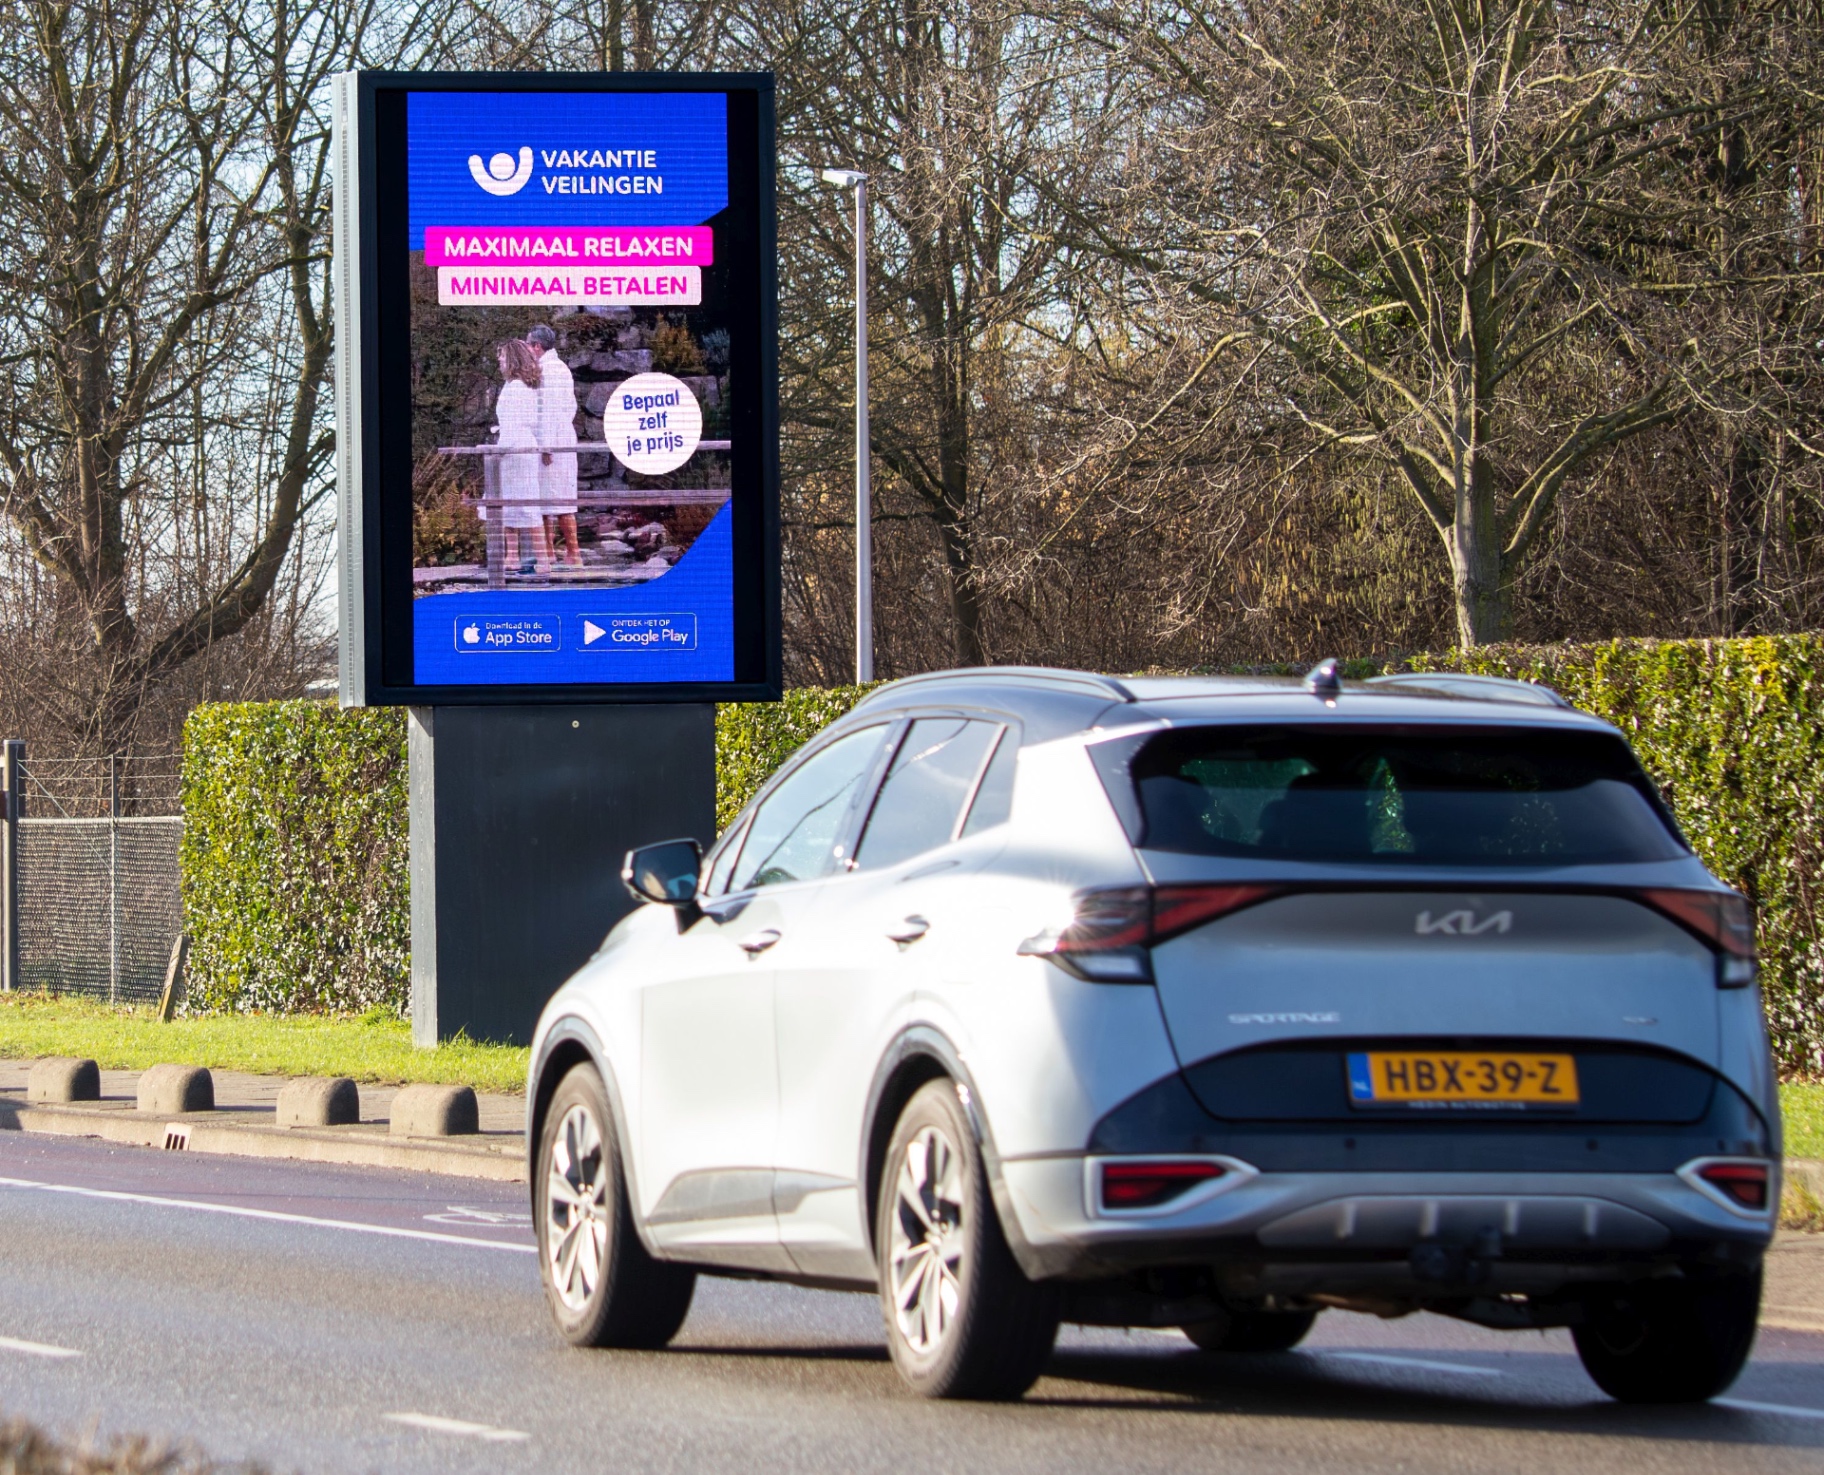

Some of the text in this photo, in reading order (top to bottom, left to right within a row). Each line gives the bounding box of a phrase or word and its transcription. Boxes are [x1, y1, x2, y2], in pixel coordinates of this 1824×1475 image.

[541, 150, 657, 168] VAKANTIE
[541, 176, 663, 194] VEILINGEN
[444, 237, 693, 257] MAXIMAAL RELAXEN
[451, 276, 687, 295] MINIMAAL BETALEN
[623, 389, 680, 412] Bepaal
[638, 411, 668, 430] zelf
[626, 432, 684, 457] je prijs
[485, 630, 552, 646] App Store
[611, 628, 688, 645] Google Play
[1415, 910, 1513, 934] KIA
[1383, 1059, 1562, 1095] HBX-39-Z
